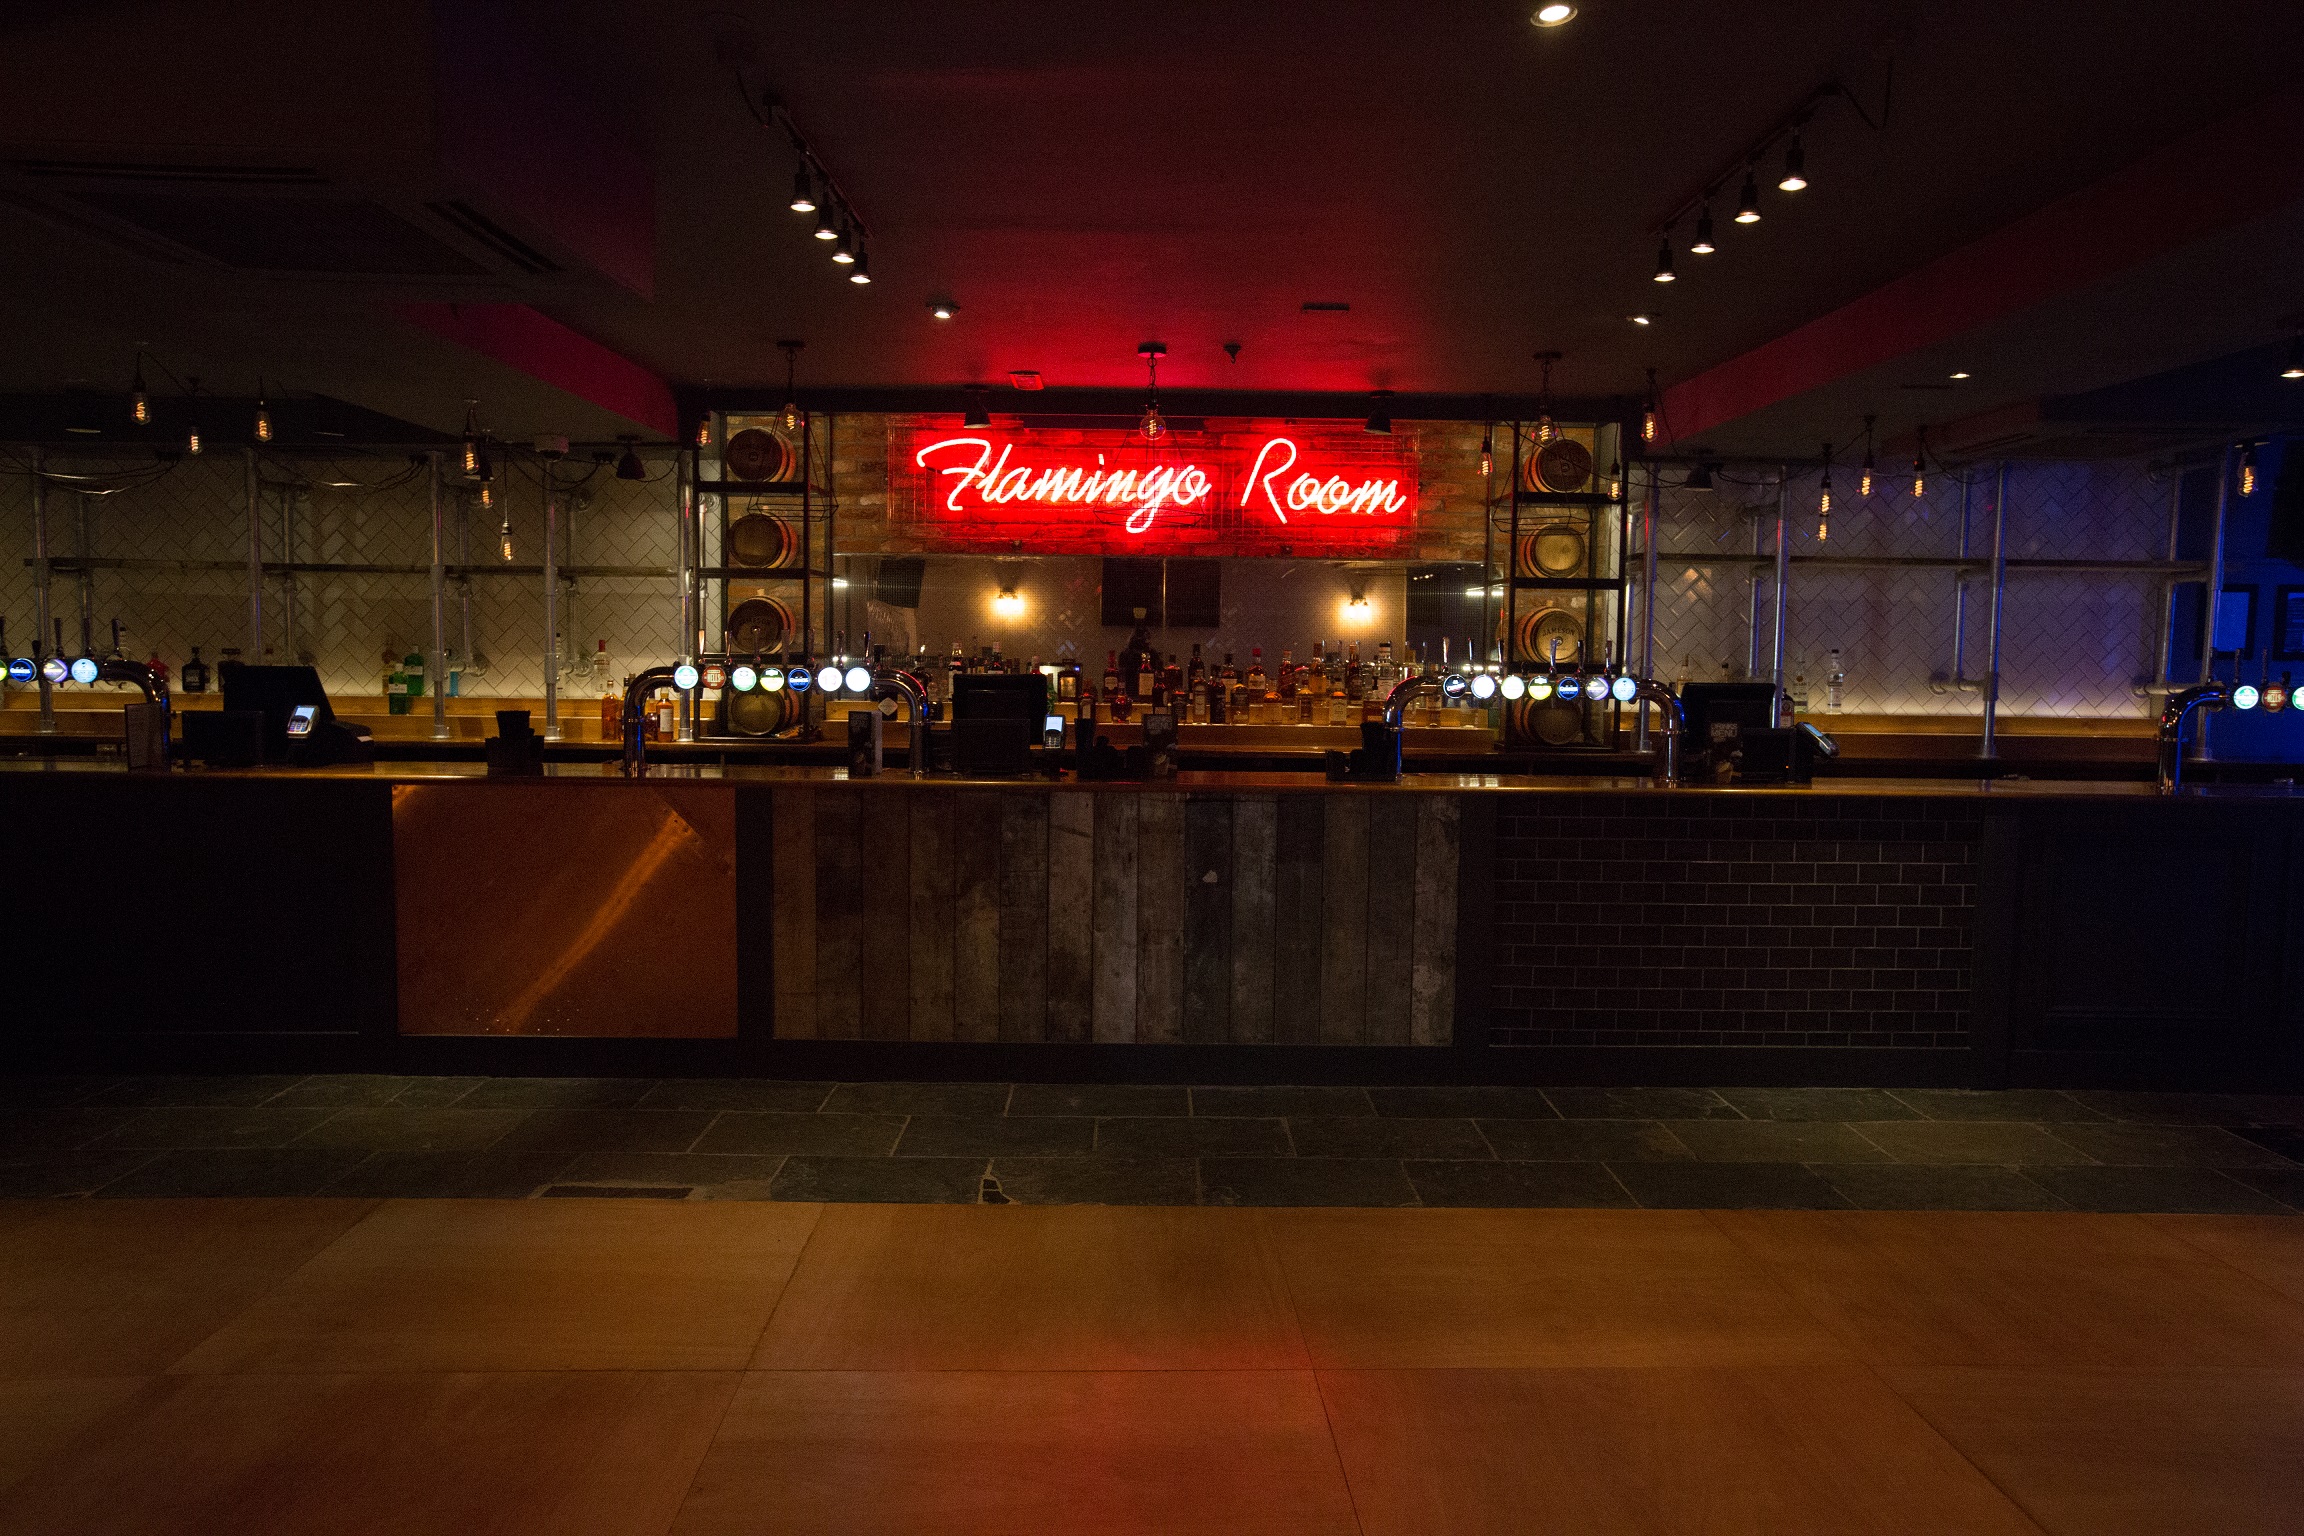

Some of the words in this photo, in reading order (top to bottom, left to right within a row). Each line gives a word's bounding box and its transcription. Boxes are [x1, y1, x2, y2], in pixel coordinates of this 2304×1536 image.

[917, 438, 1212, 534] Flamingo
[1240, 437, 1407, 525] Room
[1542, 627, 1576, 637] JAMESON
[1711, 729, 1738, 738] MENU
